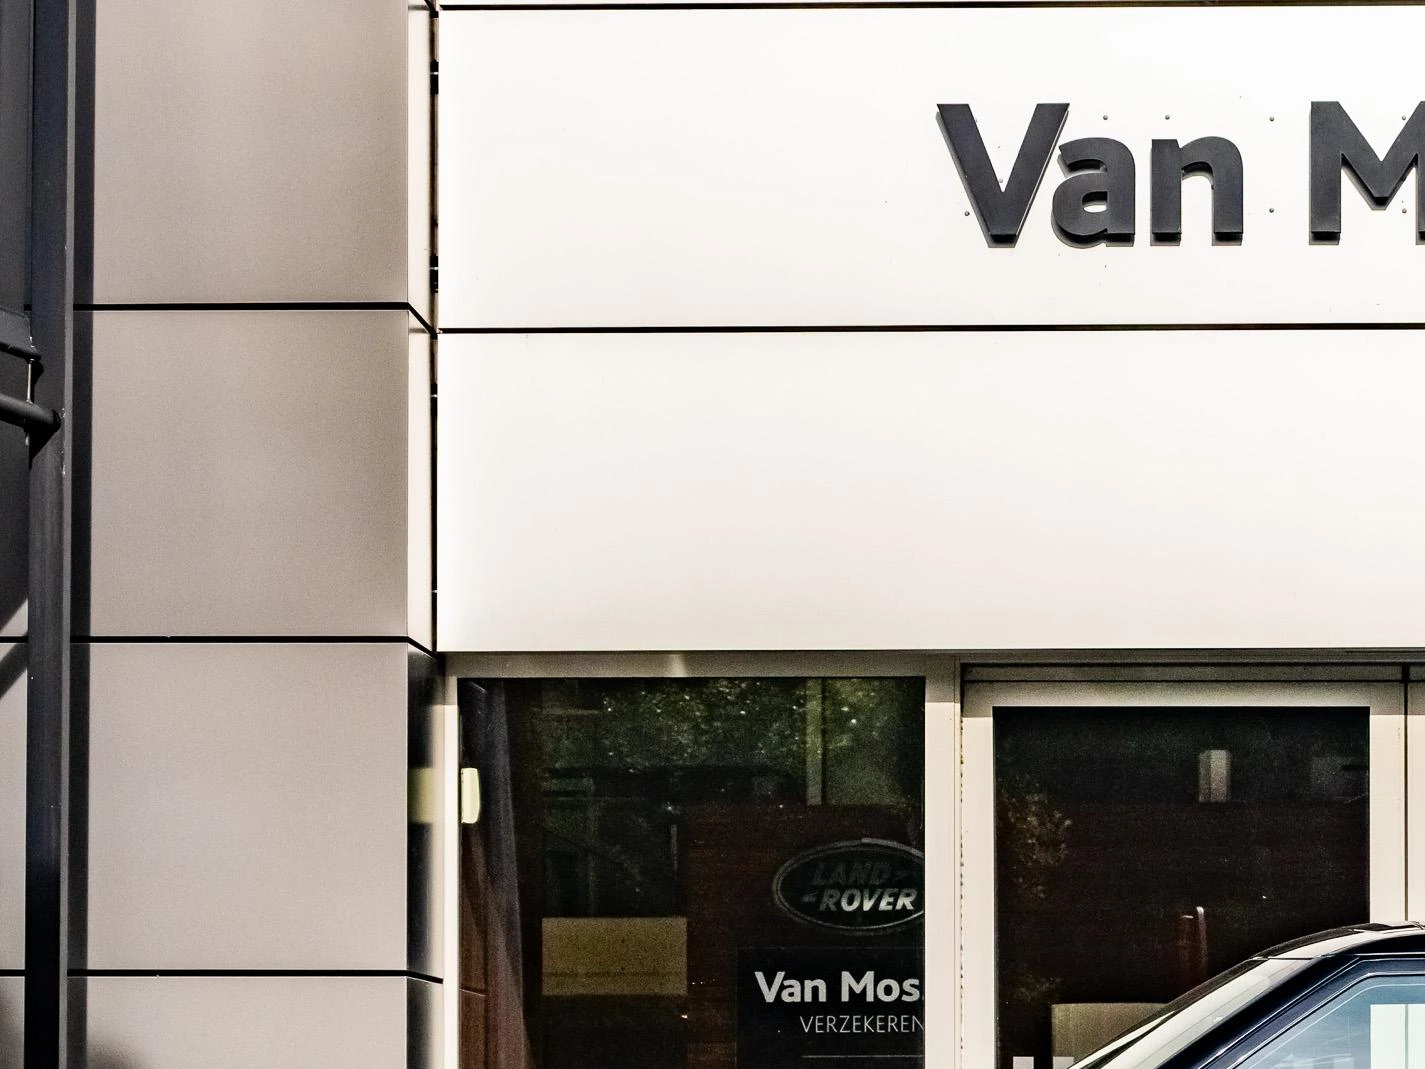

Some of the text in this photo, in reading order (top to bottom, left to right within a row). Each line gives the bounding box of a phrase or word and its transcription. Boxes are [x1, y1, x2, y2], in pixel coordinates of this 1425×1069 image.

[936, 102, 1245, 244] Van
[811, 861, 890, 885] LAND
[819, 888, 918, 912] ROVER
[754, 970, 924, 1003] Van Mos
